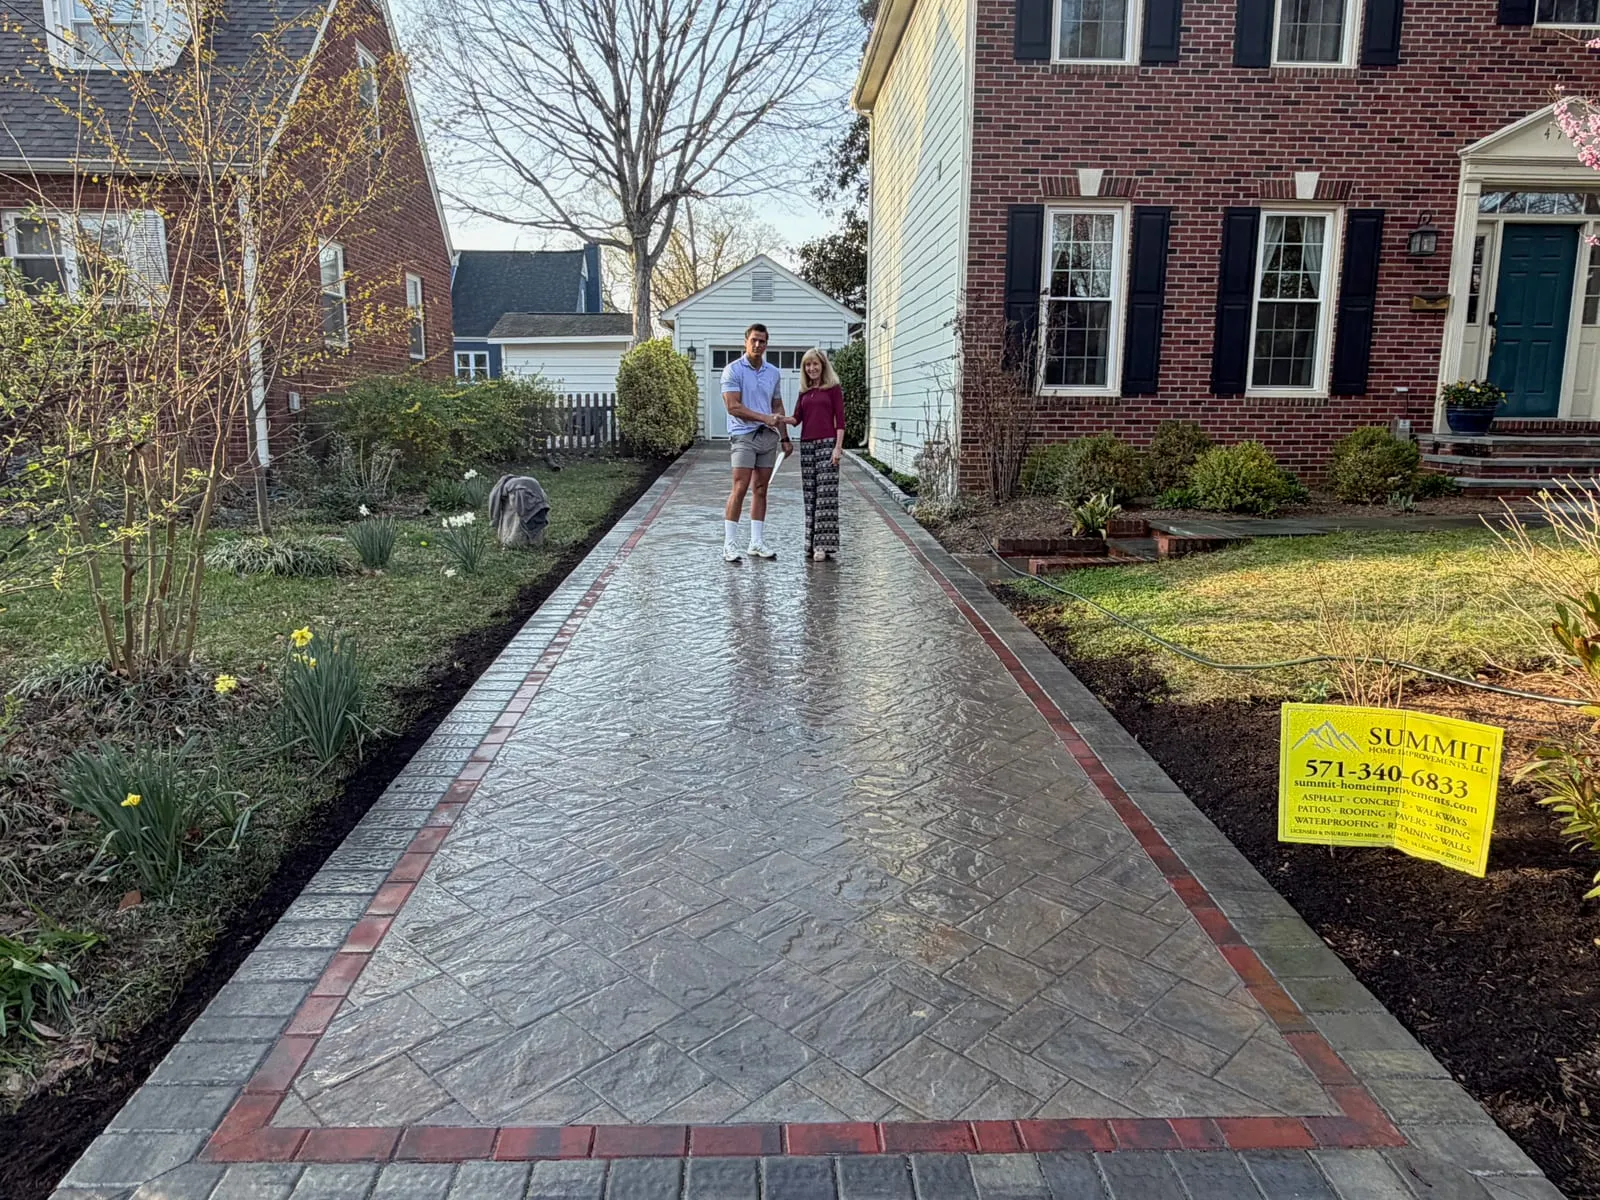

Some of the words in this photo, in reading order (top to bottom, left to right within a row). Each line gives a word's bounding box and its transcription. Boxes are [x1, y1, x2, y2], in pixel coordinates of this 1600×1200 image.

[1368, 727, 1490, 764] SUMMIT
[1368, 746, 1395, 755] HOME
[1471, 764, 1488, 775] LLC
[1294, 779, 1478, 815] summit-homeimprovements.com
[1305, 759, 1468, 799] 571-340-6833
[1297, 804, 1332, 814] PATIOS
[1339, 807, 1386, 818] ROOFING
[1394, 811, 1427, 827] PAVERS
[1434, 823, 1471, 841] SIDING
[1301, 793, 1345, 803] ASPHALT
[1352, 796, 1408, 810] CONCRETE
[1415, 805, 1469, 827] WALKWAYS
[1294, 816, 1379, 829] WATERPROOFING
[1440, 836, 1473, 854] WALLS
